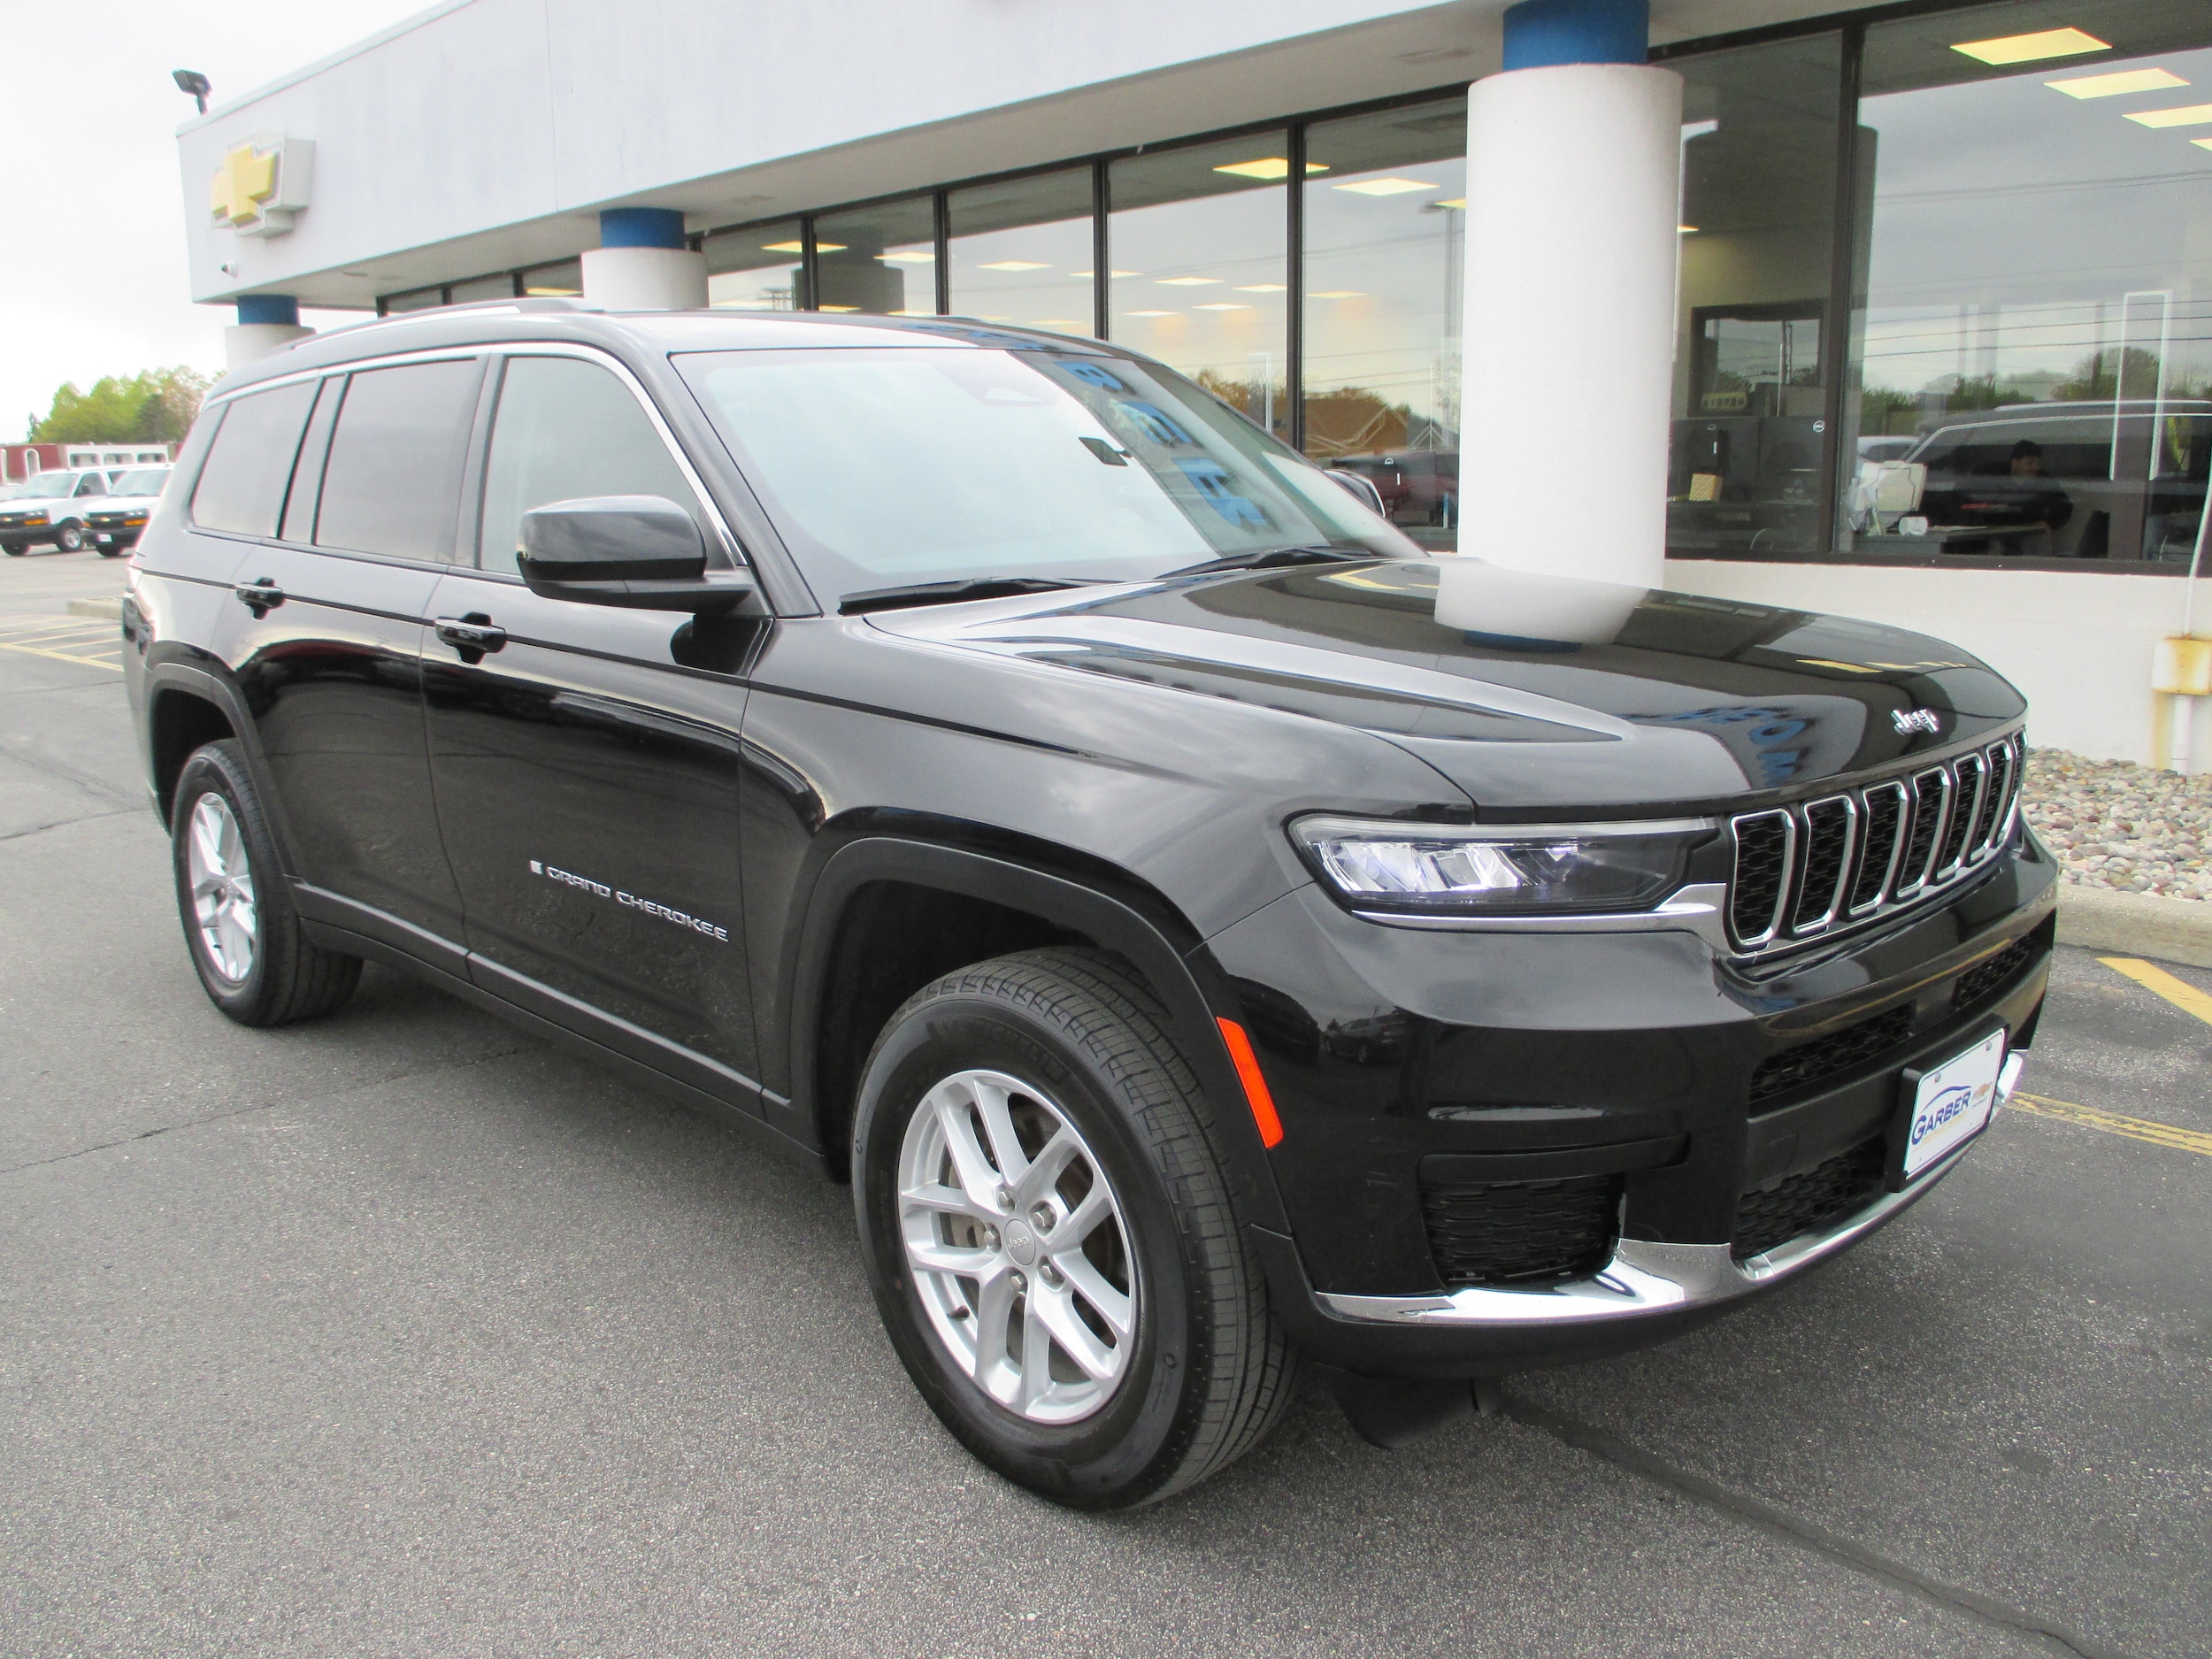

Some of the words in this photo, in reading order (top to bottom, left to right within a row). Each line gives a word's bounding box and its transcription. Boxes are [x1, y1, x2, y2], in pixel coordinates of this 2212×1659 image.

[1891, 709, 1939, 735] Jeep
[547, 866, 611, 898] GRAND
[616, 890, 729, 941] CHEROKEE
[1912, 1091, 1970, 1145] GARBER
[1009, 1236, 1029, 1248] Jeep
